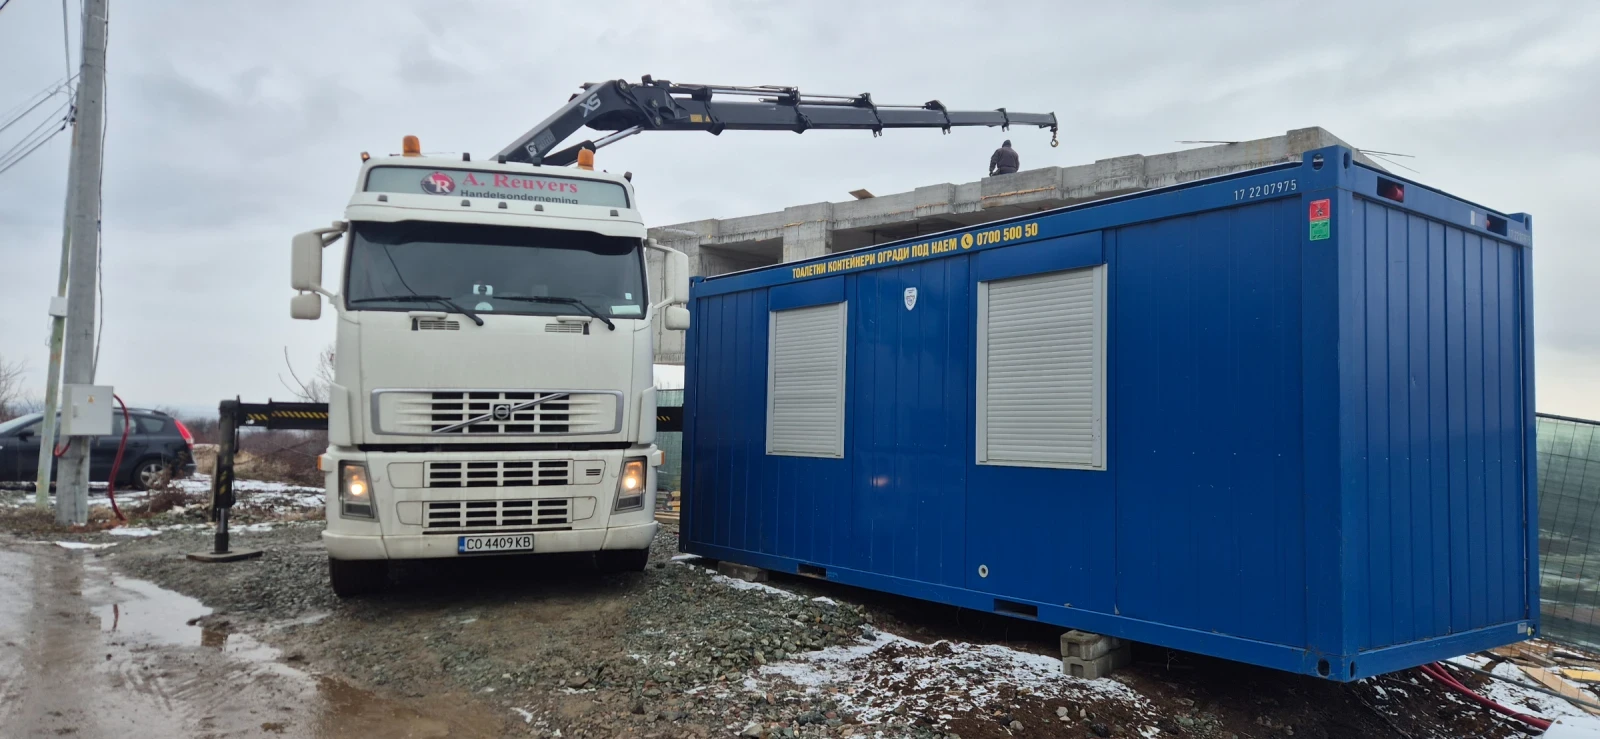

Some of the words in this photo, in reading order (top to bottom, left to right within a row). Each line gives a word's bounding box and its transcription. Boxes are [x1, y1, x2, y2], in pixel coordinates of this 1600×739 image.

[579, 92, 601, 118] XS
[462, 172, 485, 186] A.
[493, 173, 578, 193] Reuvers
[792, 262, 826, 279] ТОАЛЕТНИ
[827, 253, 876, 273] КОНТЕЙНЕРИ
[877, 246, 910, 264] ОГРАДИ
[911, 243, 929, 258] ПОД
[931, 238, 957, 254] НАЕМ
[976, 229, 1001, 246] 0700
[1003, 225, 1022, 241] 500
[1024, 222, 1038, 238] 50
[484, 537, 513, 549] 4409
[515, 536, 531, 548] KB
